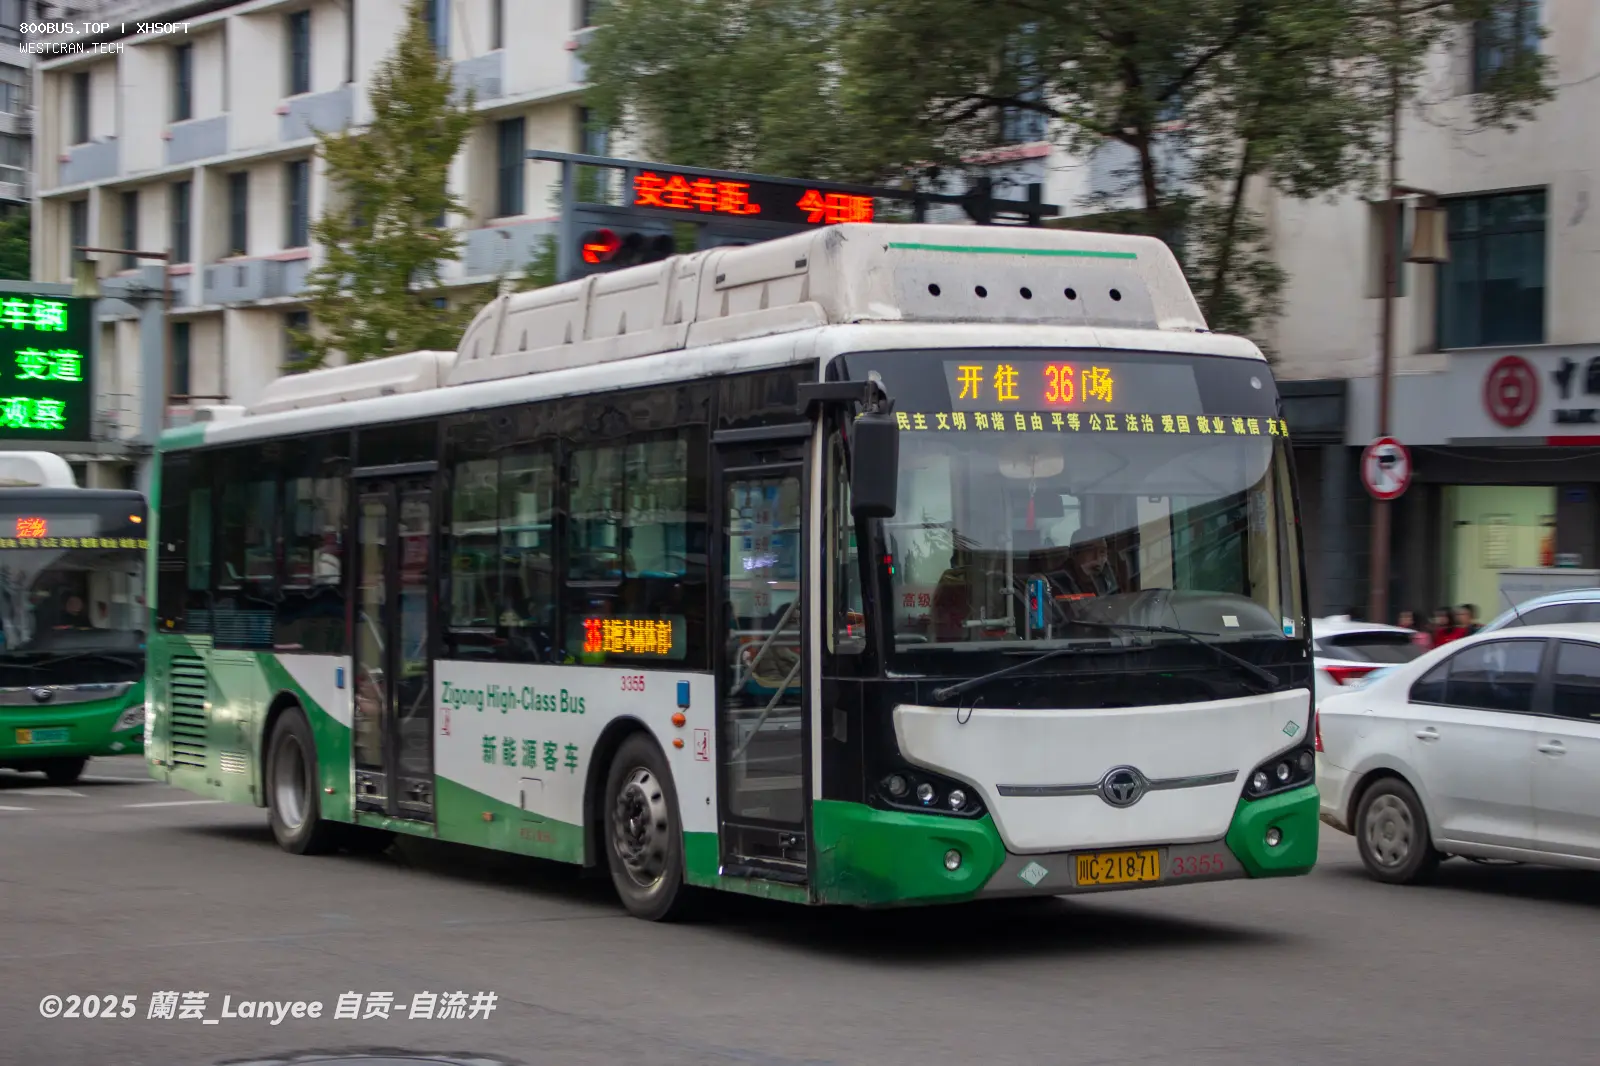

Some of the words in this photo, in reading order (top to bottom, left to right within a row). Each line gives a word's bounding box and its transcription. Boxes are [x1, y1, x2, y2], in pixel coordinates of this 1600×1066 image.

[15, 347, 84, 382] 变道
[957, 364, 1020, 402] 开往
[1044, 364, 1074, 403] 36
[896, 412, 928, 430] 民主
[936, 412, 967, 431] 文明
[975, 412, 1005, 431] 和谐
[1014, 412, 1043, 431] 自由
[1051, 412, 1081, 432] 平等
[1088, 413, 1118, 431] 公正
[1125, 414, 1154, 433] 法治
[1161, 415, 1191, 433] 爱国
[1197, 415, 1226, 434] 敬业
[1232, 417, 1260, 435] 诚信
[441, 680, 484, 712] Zigong
[486, 683, 557, 714] High-Class
[559, 688, 586, 714] Bus
[620, 675, 646, 692] 3355
[482, 734, 579, 774] 新能源客车
[1172, 853, 1224, 877] 3355
